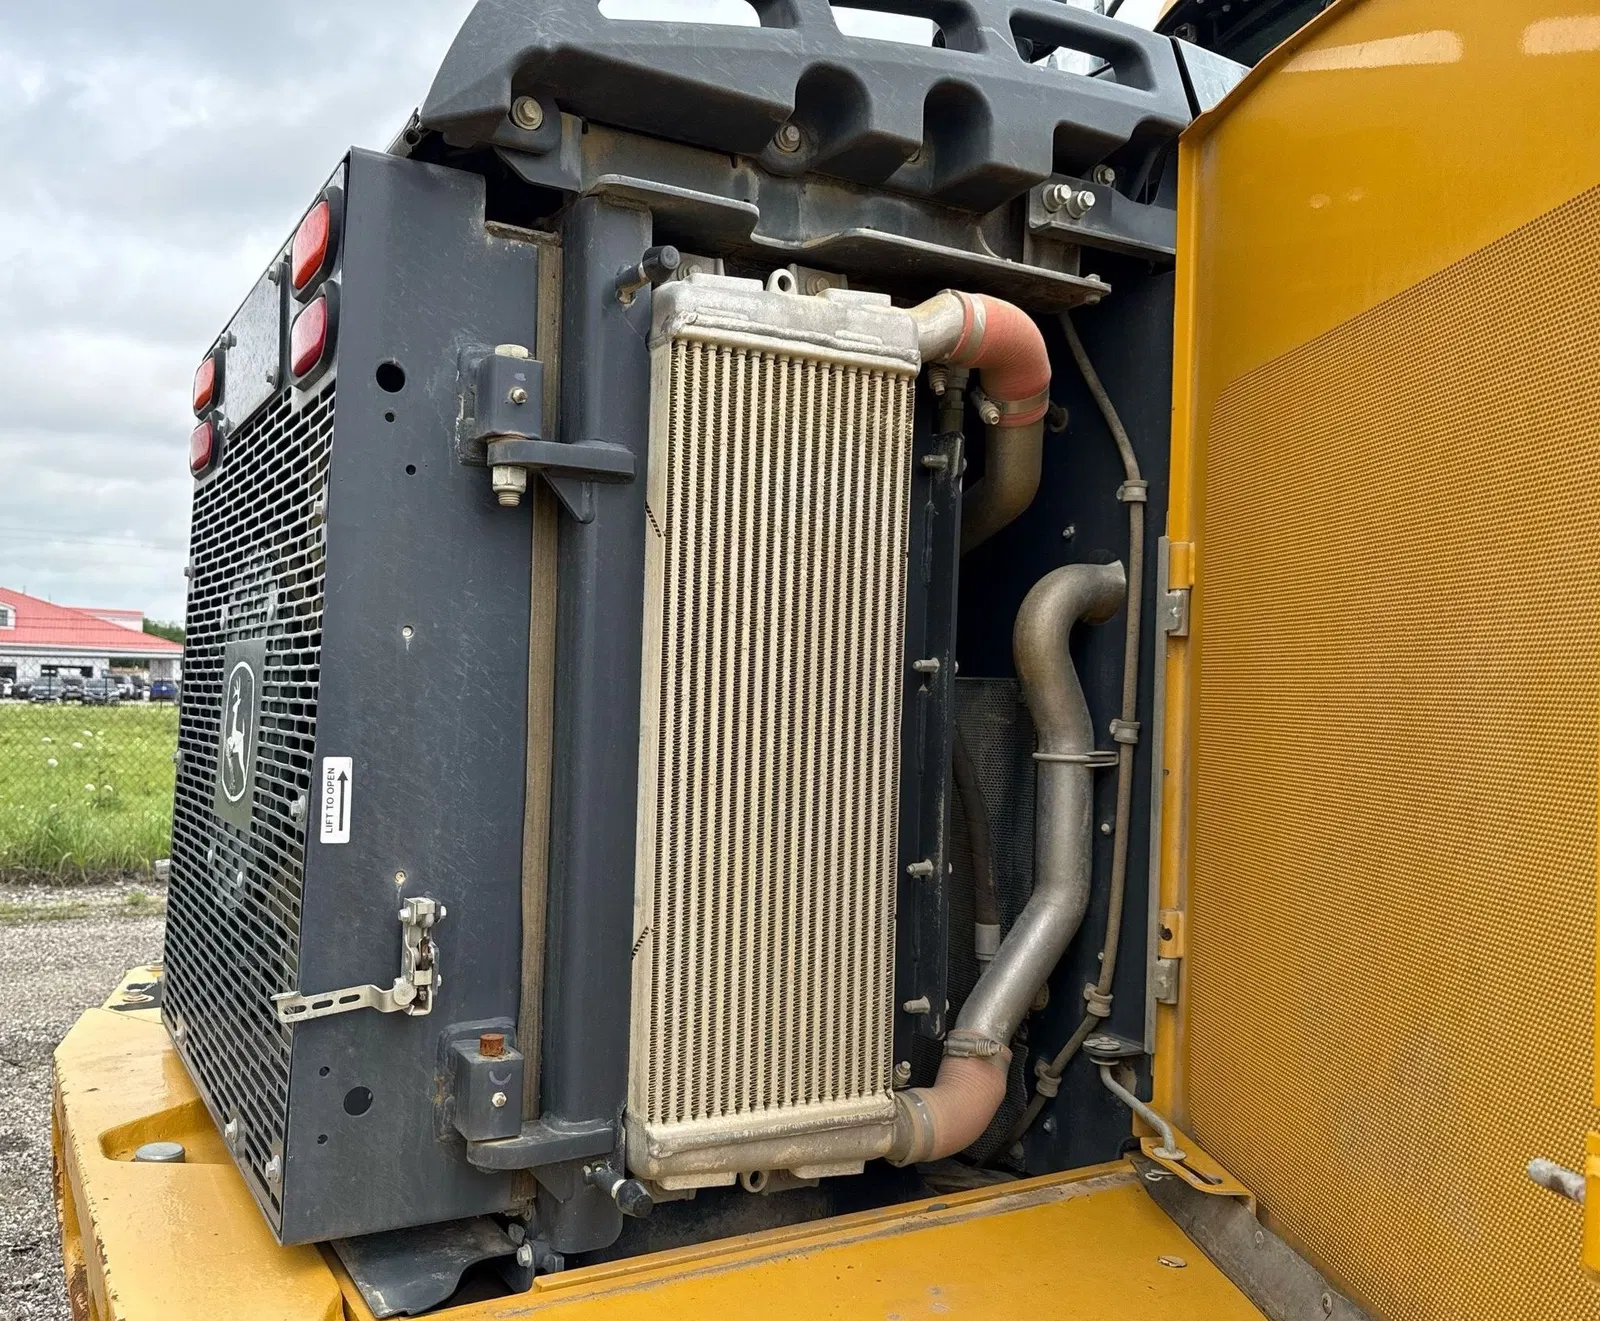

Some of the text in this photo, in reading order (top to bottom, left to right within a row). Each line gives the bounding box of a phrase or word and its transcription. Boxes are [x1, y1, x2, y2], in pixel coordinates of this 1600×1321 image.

[325, 767, 335, 833] LIFT TO OPEN
